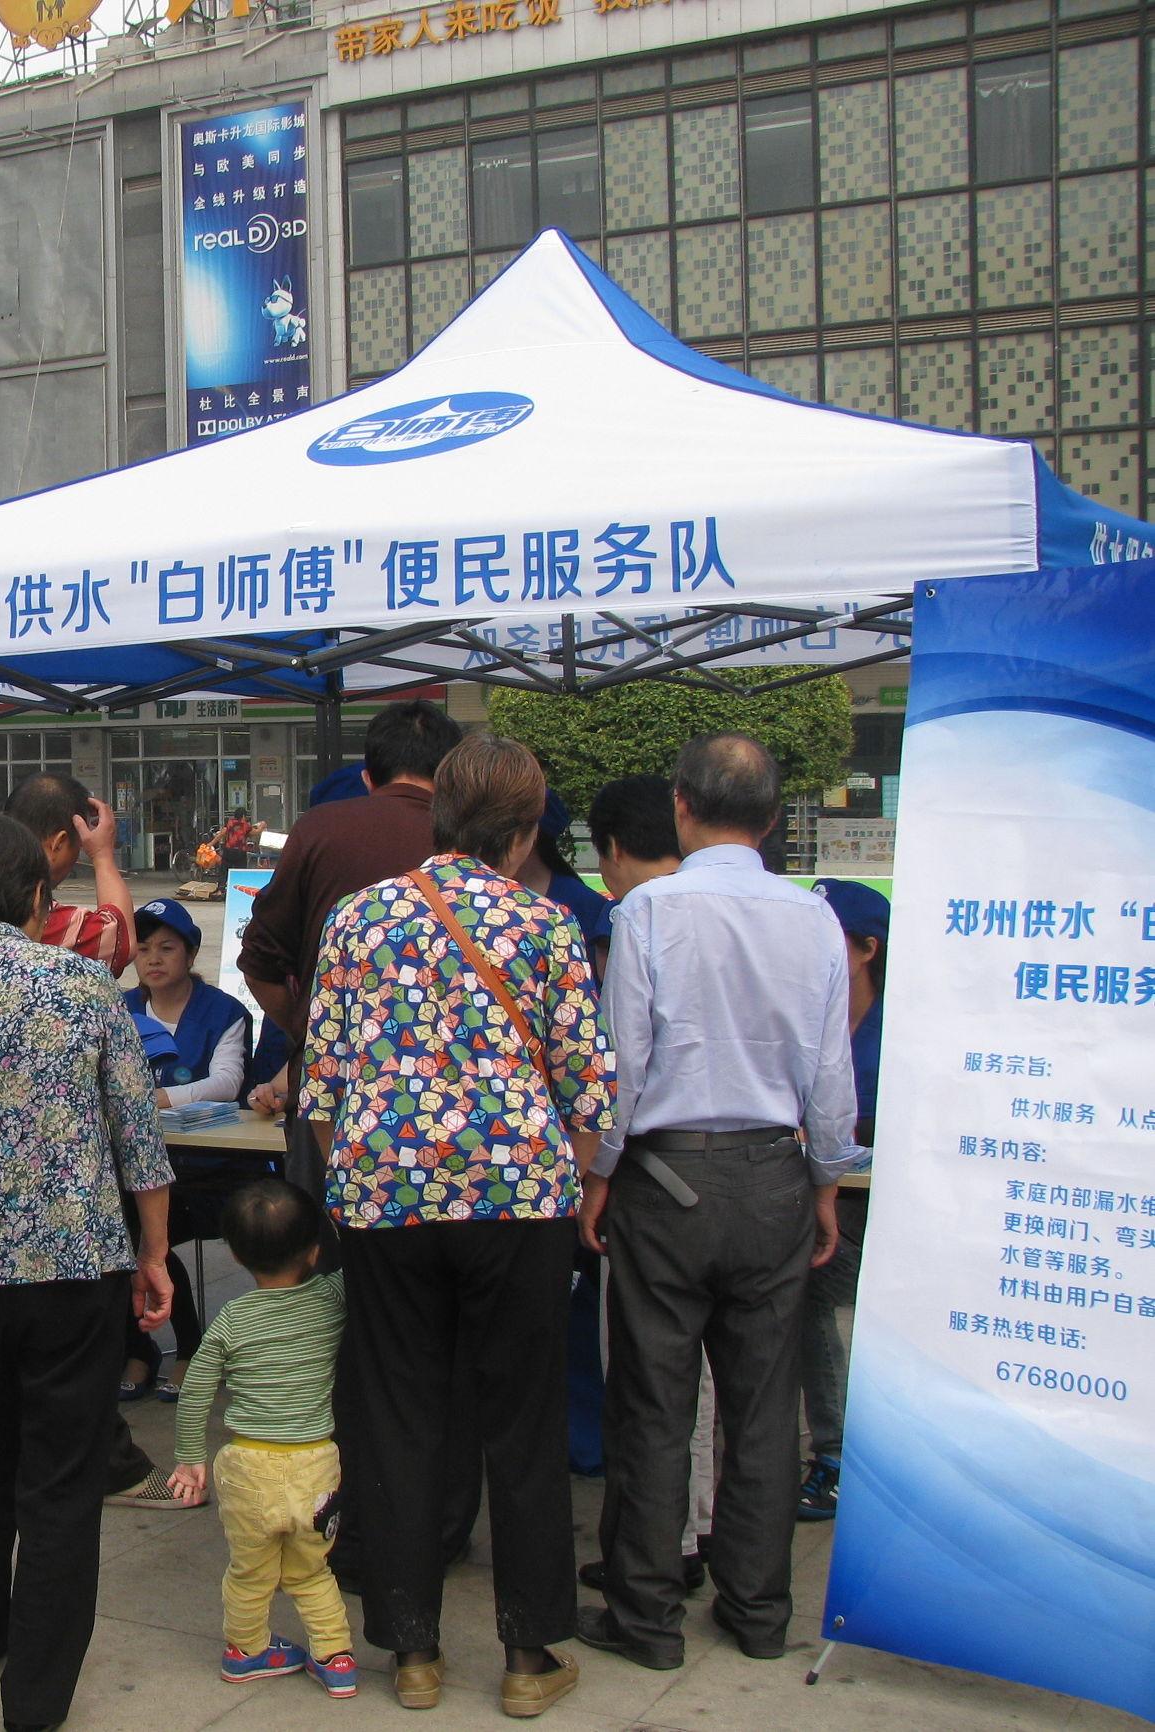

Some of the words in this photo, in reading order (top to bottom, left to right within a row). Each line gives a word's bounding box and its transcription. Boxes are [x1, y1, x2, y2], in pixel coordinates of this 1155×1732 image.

[334, 0, 562, 62] 带家人来吃饭
[193, 113, 306, 147] 奥斯卡升龙国际影城
[219, 415, 264, 433] DOLBY
[197, 700, 238, 717] 生活超市
[946, 898, 1095, 940] 郑州供水
[1010, 1097, 1095, 1125] 供水服务
[996, 1361, 1127, 1401] 67680000
